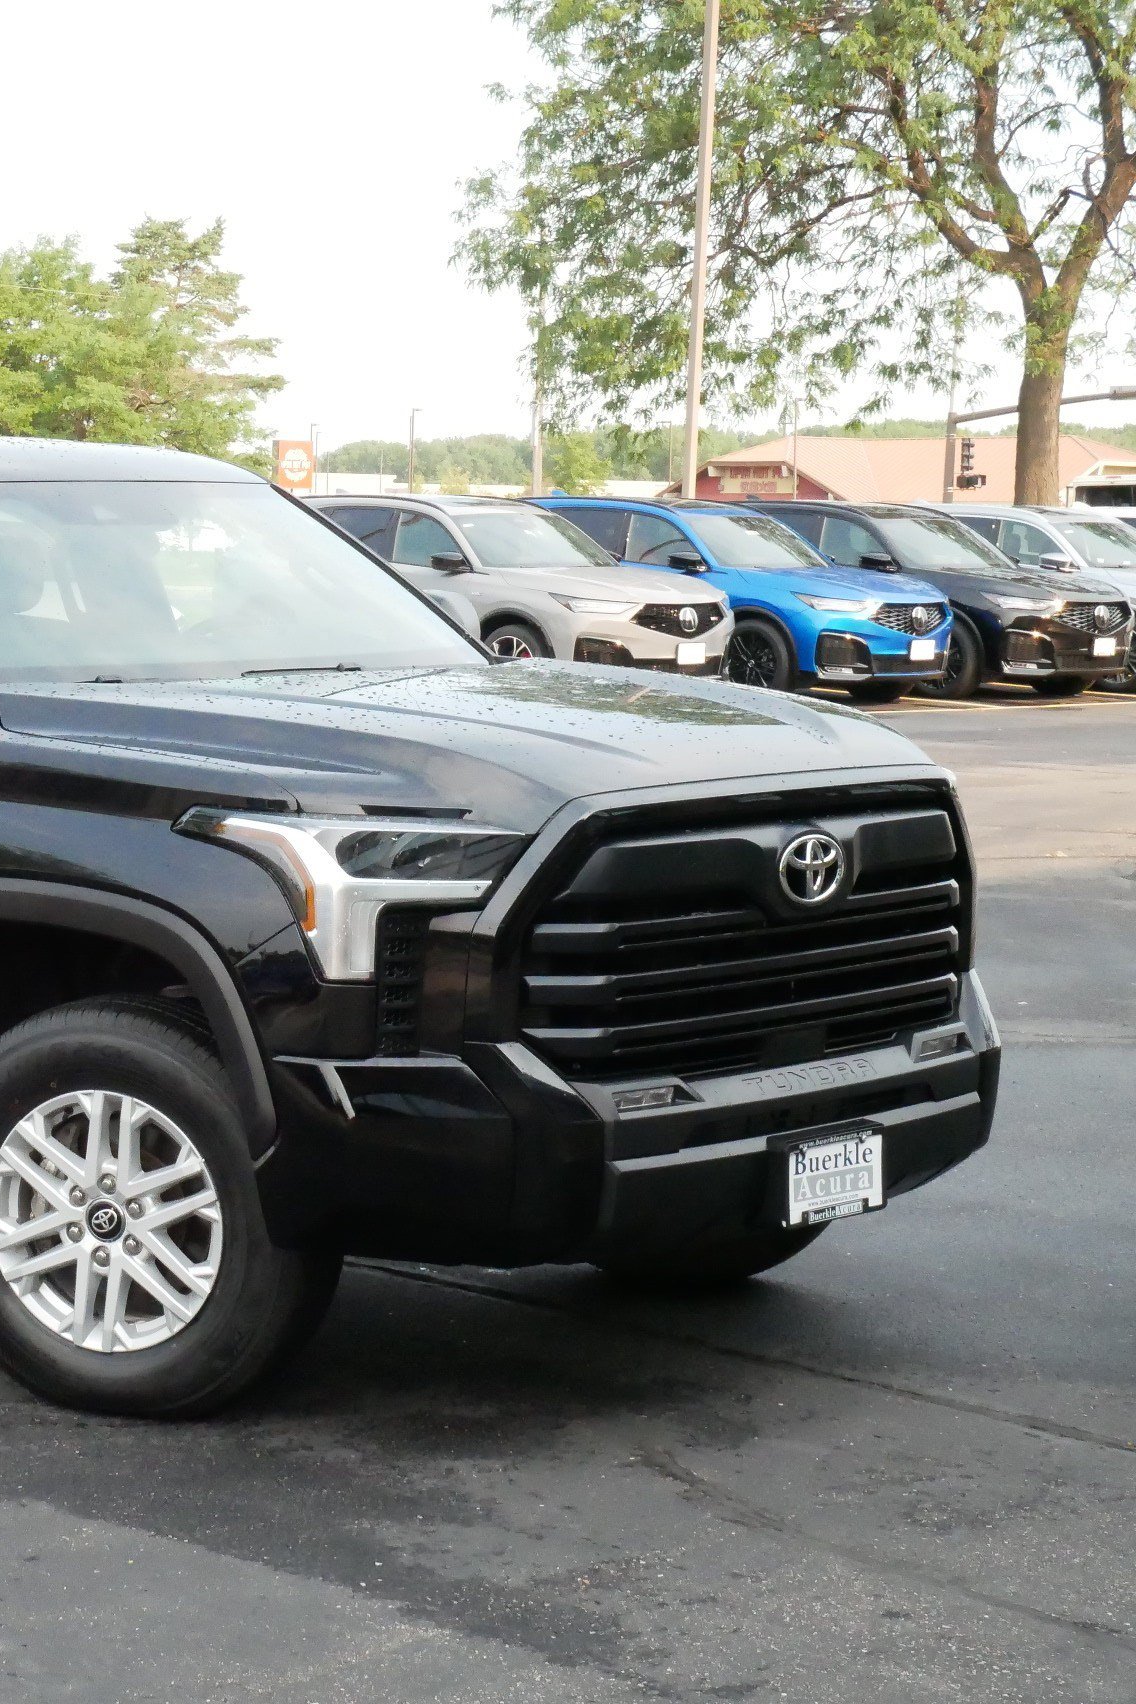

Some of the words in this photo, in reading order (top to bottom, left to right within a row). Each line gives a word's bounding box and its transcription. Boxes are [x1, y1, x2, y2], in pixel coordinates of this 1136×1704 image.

[742, 1058, 877, 1095] TUNDRA
[793, 1141, 873, 1176] Buerkle
[797, 1171, 870, 1200] Acura
[810, 1207, 836, 1221] Buerkle
